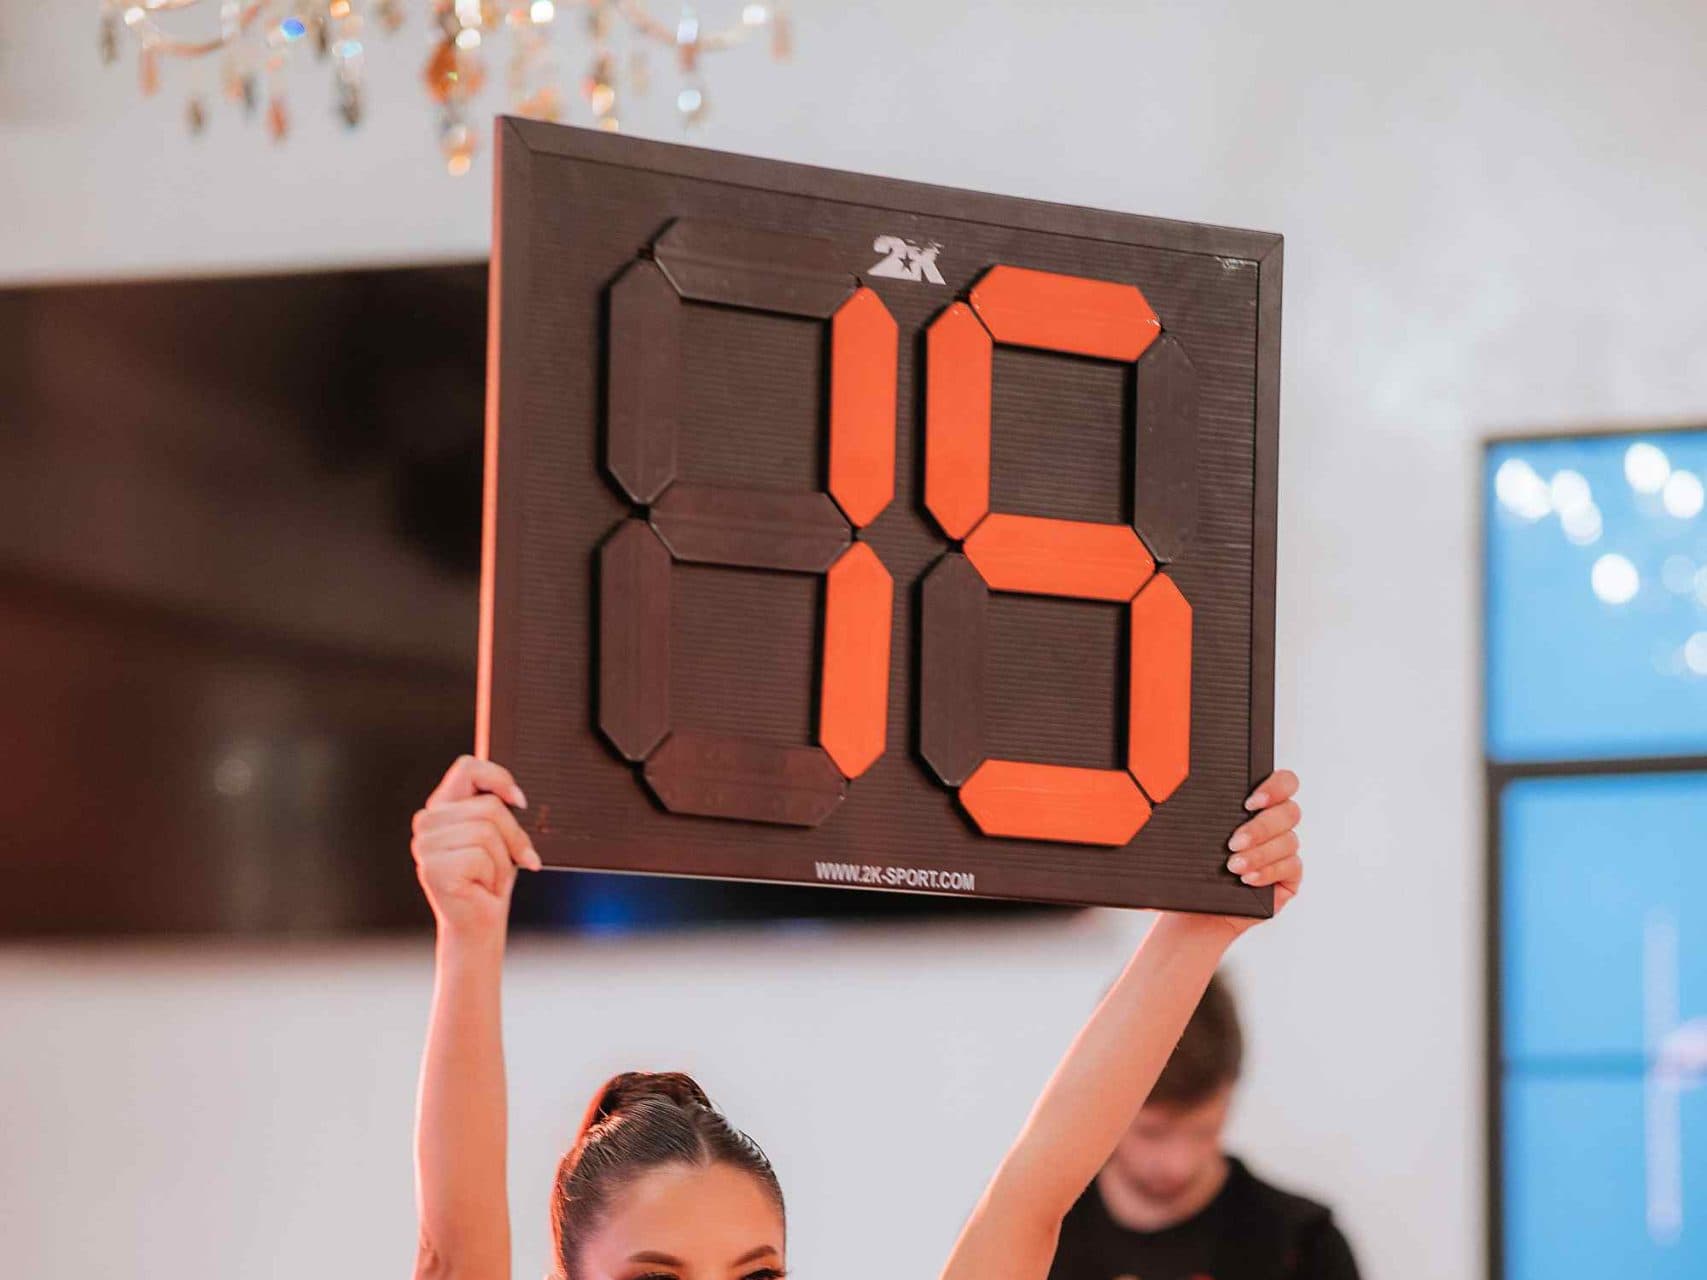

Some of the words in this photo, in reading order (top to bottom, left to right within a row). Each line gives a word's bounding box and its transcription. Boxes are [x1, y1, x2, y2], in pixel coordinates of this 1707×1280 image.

[866, 234, 946, 286] 2K
[818, 264, 1193, 847] 15
[815, 861, 976, 891] WWW.2K-SPORT.COM
